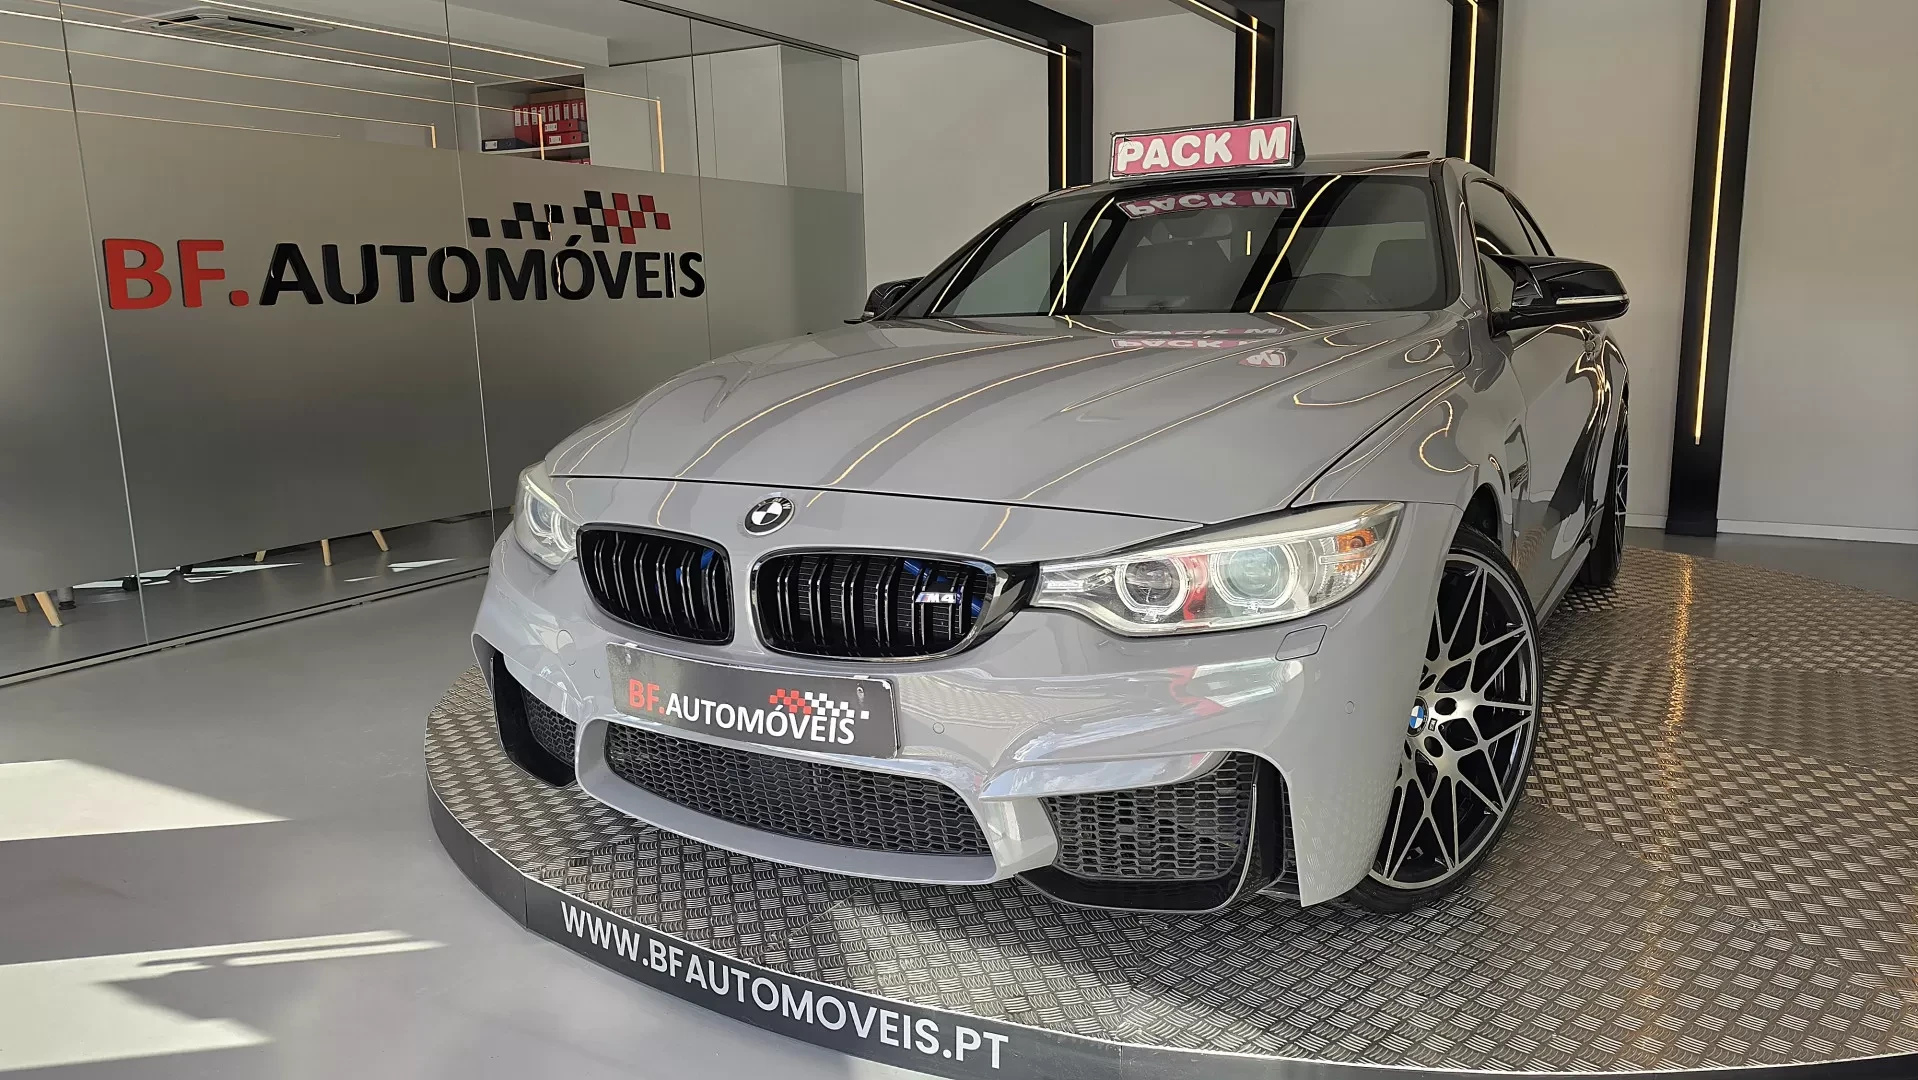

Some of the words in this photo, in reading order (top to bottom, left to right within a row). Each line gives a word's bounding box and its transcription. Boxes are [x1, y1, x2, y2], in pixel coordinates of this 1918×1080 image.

[1116, 131, 1233, 172] PACK
[1248, 126, 1287, 161] M
[560, 901, 1009, 1069] WWW.BFAUTOMOVEIS.PT
